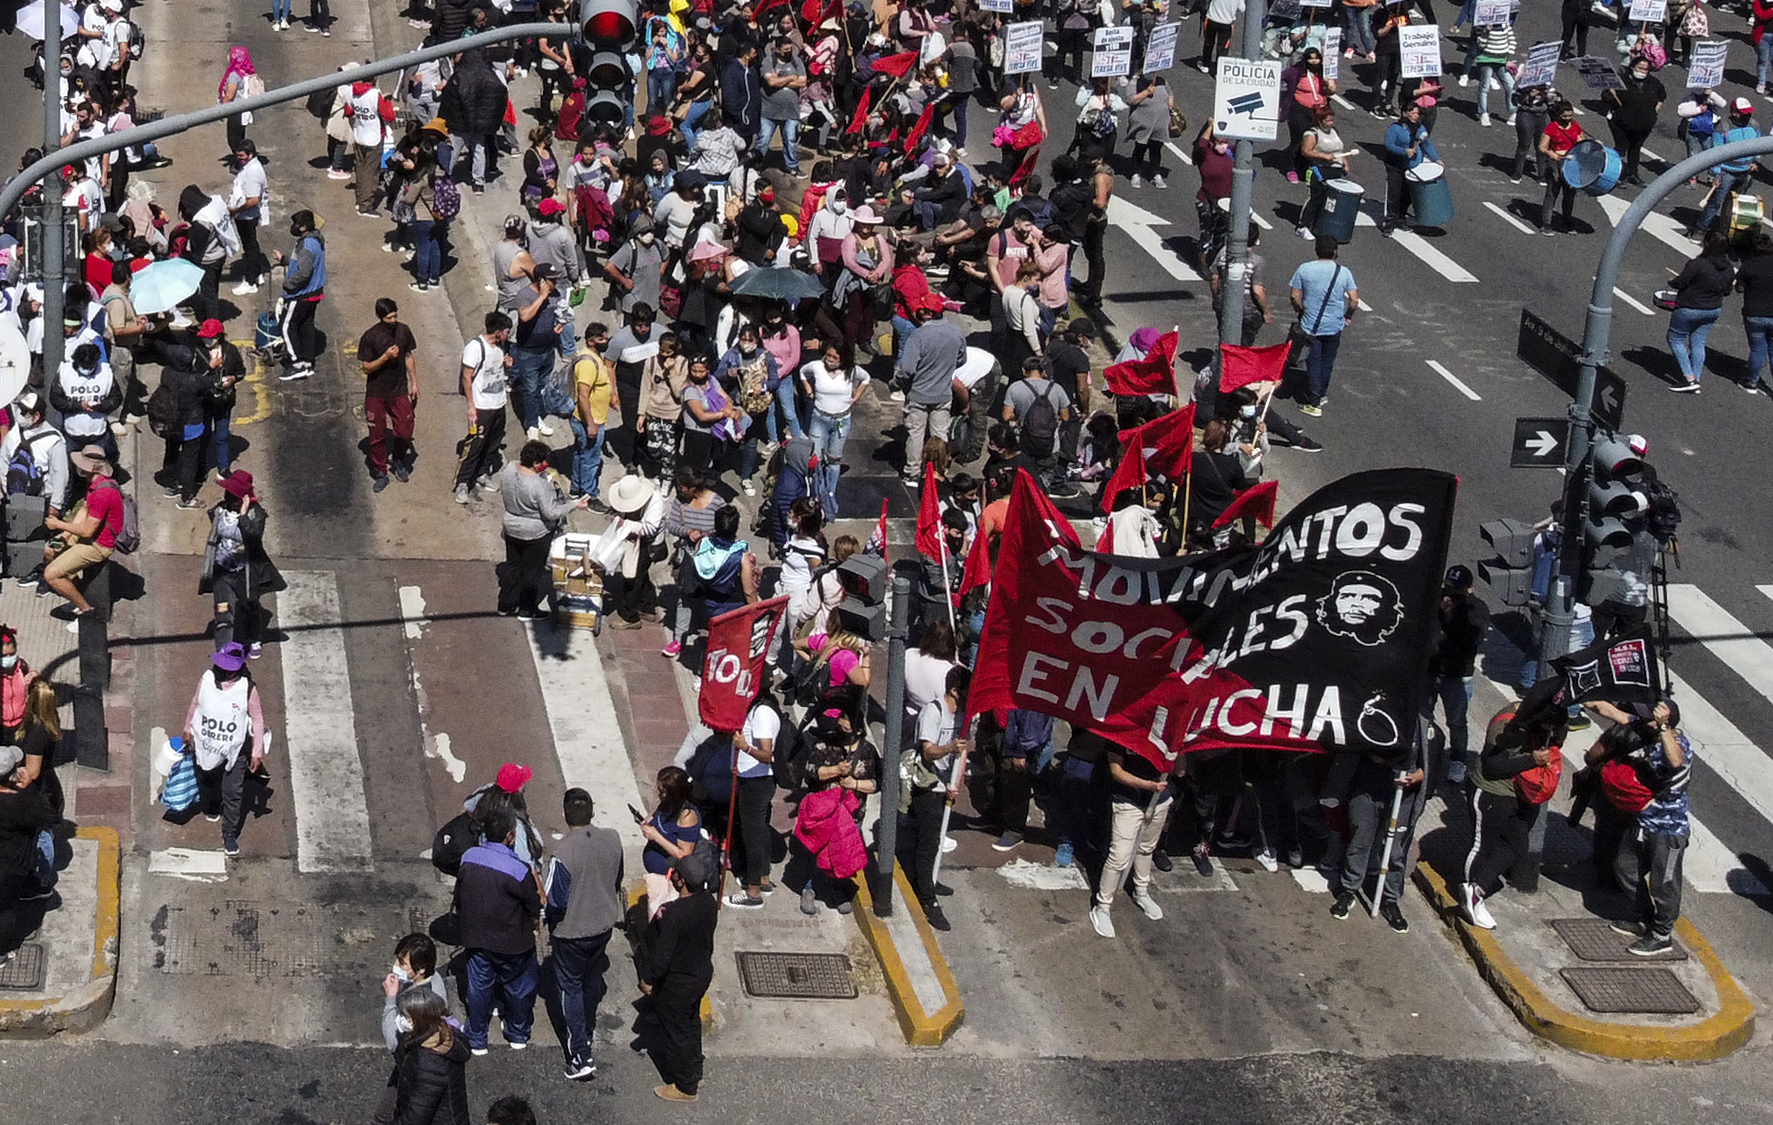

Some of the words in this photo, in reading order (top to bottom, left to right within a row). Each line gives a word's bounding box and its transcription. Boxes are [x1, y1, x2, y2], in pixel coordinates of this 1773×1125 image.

[1402, 32, 1434, 42] Trabajo
[1402, 40, 1437, 49] Genuino
[1223, 64, 1276, 80] POLICIA
[1246, 79, 1276, 87] CIUDAD
[71, 385, 100, 394] POLO
[1024, 594, 1308, 685] SOCIALES
[1016, 650, 1120, 722] EN
[1148, 683, 1346, 761] LUCHA
[201, 715, 236, 734] POLO
